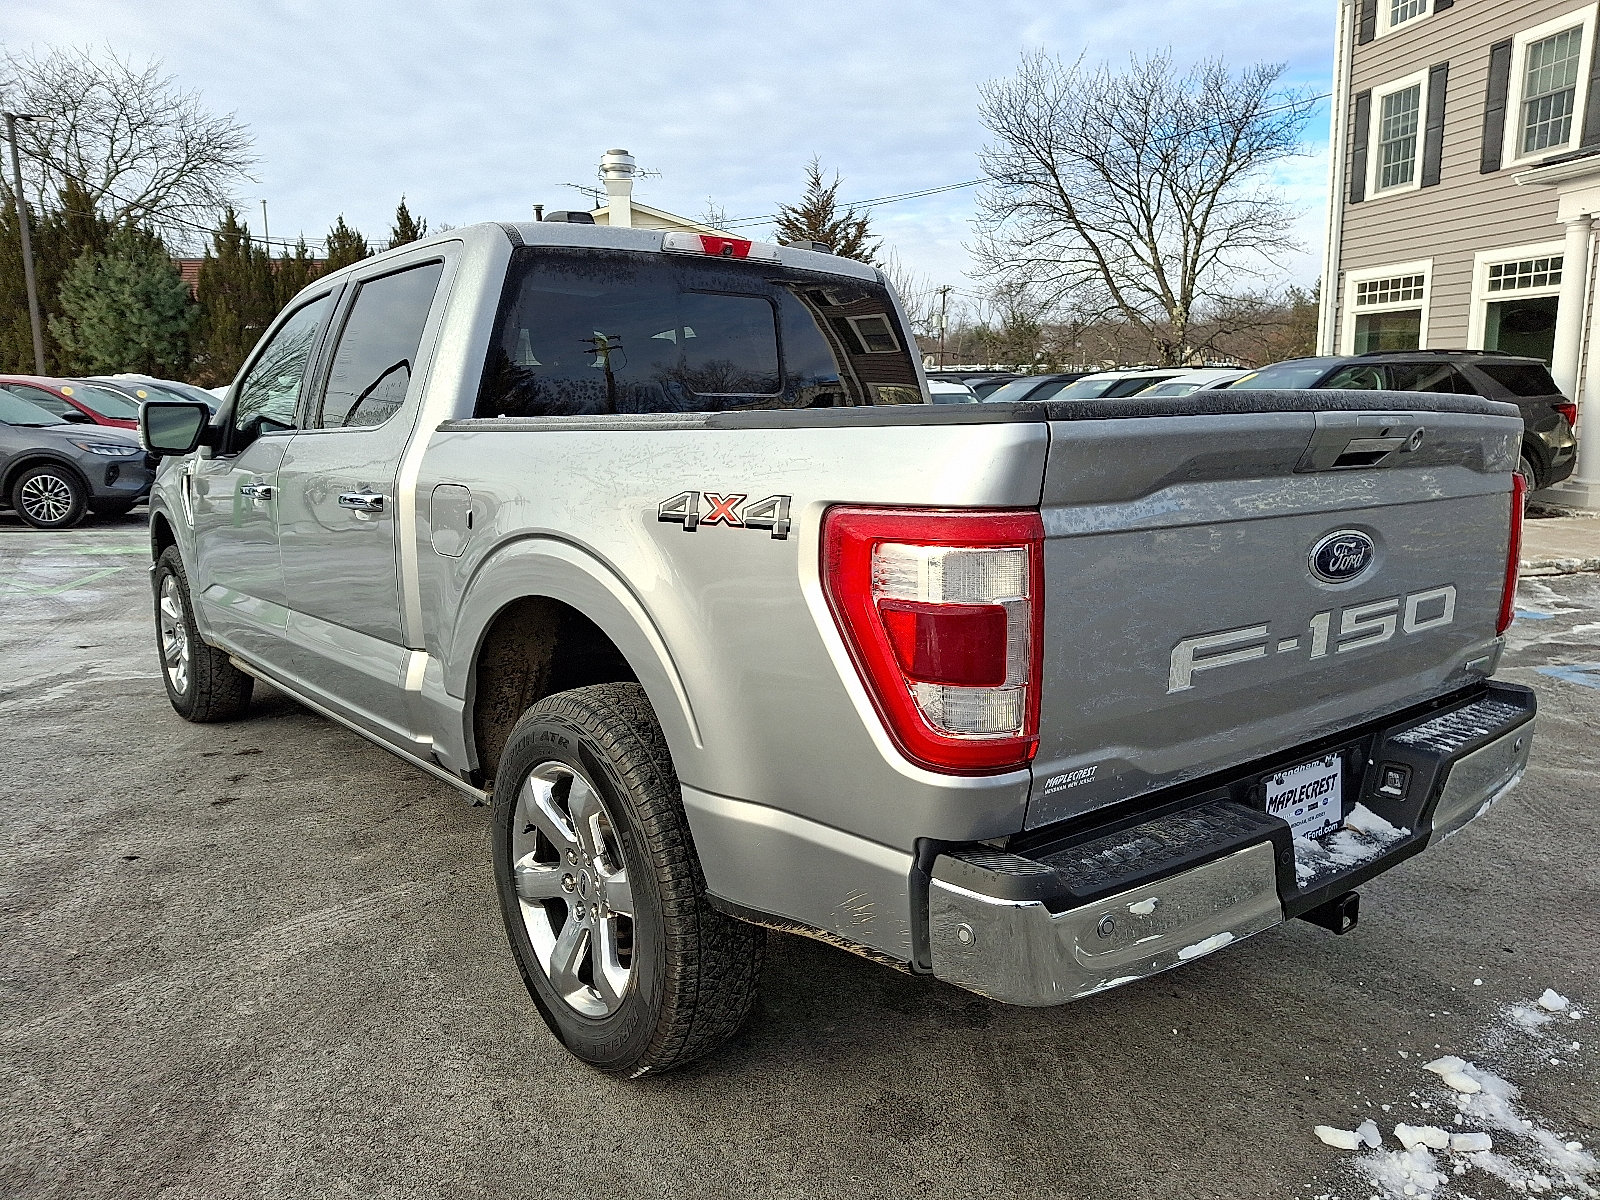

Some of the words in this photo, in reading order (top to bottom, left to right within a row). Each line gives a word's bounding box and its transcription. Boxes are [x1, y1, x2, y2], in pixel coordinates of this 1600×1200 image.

[1329, 542, 1365, 573] Ford
[1166, 585, 1457, 694] F-150
[1044, 765, 1098, 789] MAPLECREST
[1267, 773, 1338, 813] MAPLECREST
